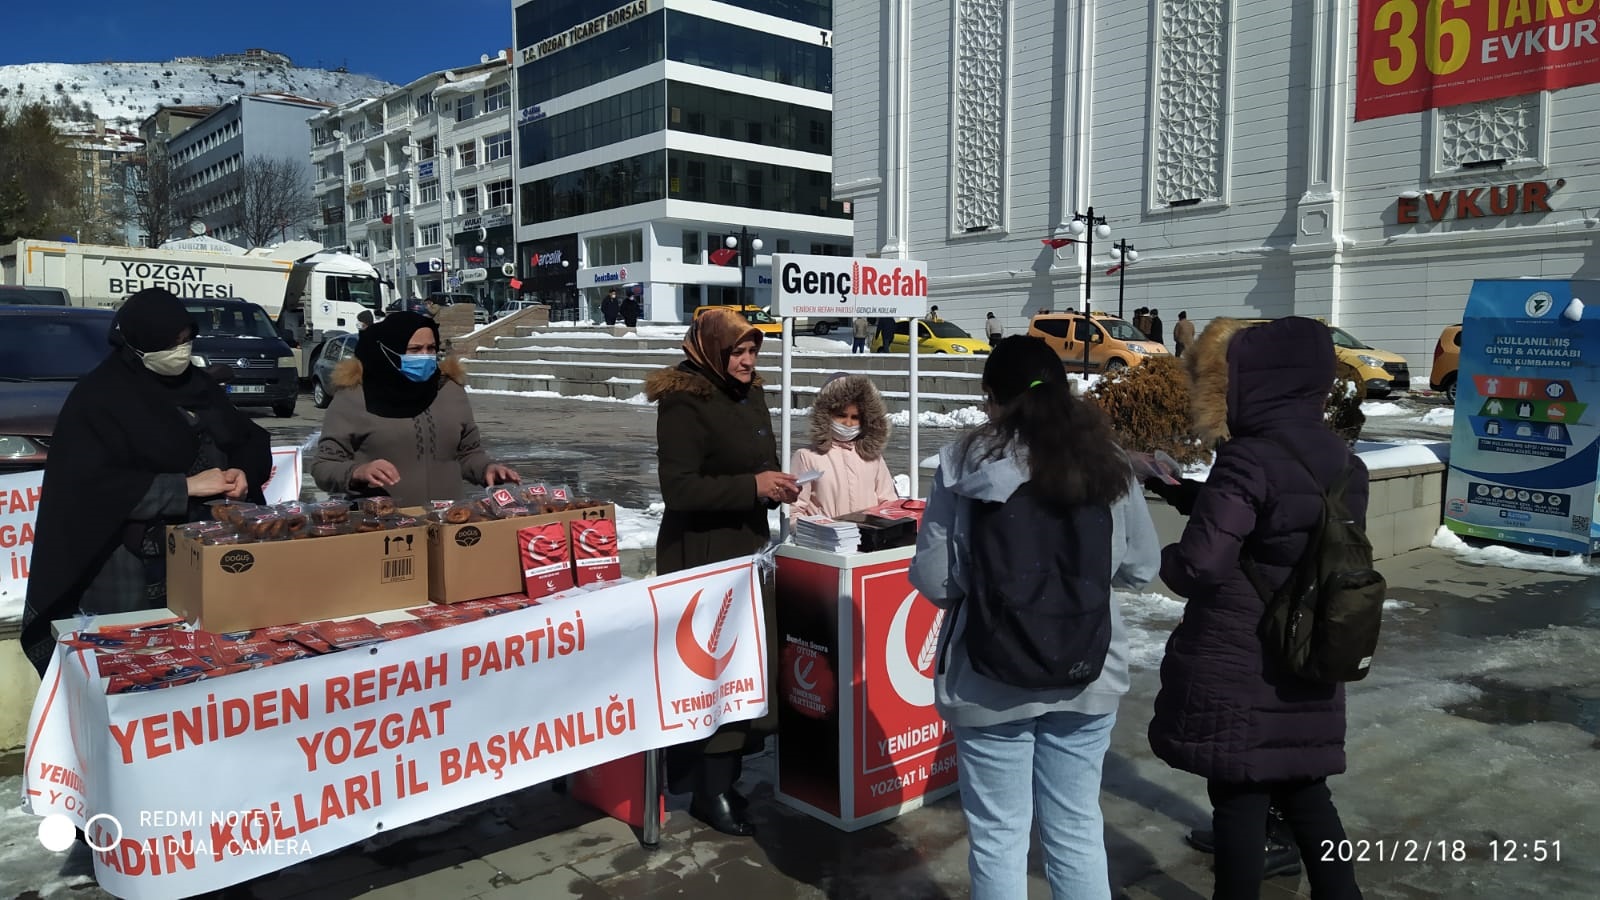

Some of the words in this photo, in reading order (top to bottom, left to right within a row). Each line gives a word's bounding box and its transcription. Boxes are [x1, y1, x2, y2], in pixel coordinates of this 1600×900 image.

[523, 50, 536, 62] T.C.
[538, 35, 568, 58] YOZGAT
[569, 25, 605, 43] TİCARET
[607, 0, 648, 28] BORSASI
[1373, 0, 1471, 86] 36
[1481, 19, 1599, 64] EVKUR
[1397, 181, 1553, 225] EVKUR
[121, 262, 207, 282] YOZGAT
[782, 262, 851, 303] Genç
[861, 266, 928, 297] Refah
[1485, 346, 1513, 355] GİYSİ
[1515, 347, 1525, 355] &
[1526, 348, 1581, 358] AYAKKABI
[1496, 336, 1570, 350] KULLANILMIŞ
[1514, 358, 1570, 367] KUMBARASI
[108, 683, 309, 765] YENİDEN
[325, 652, 449, 714] REFAH
[460, 609, 586, 681] PARTİSİ
[720, 677, 755, 698] REFAH
[687, 698, 743, 730] YOGAT
[296, 699, 452, 772] YOZGAT
[877, 721, 939, 757] YENİDEN
[210, 769, 382, 863] KOLLARI
[395, 754, 429, 800] İL
[439, 693, 637, 786] BAŞKANLIĞI
[870, 770, 917, 797] YOZGAT
[918, 764, 929, 781] İL
[931, 752, 958, 776] BAŞK
